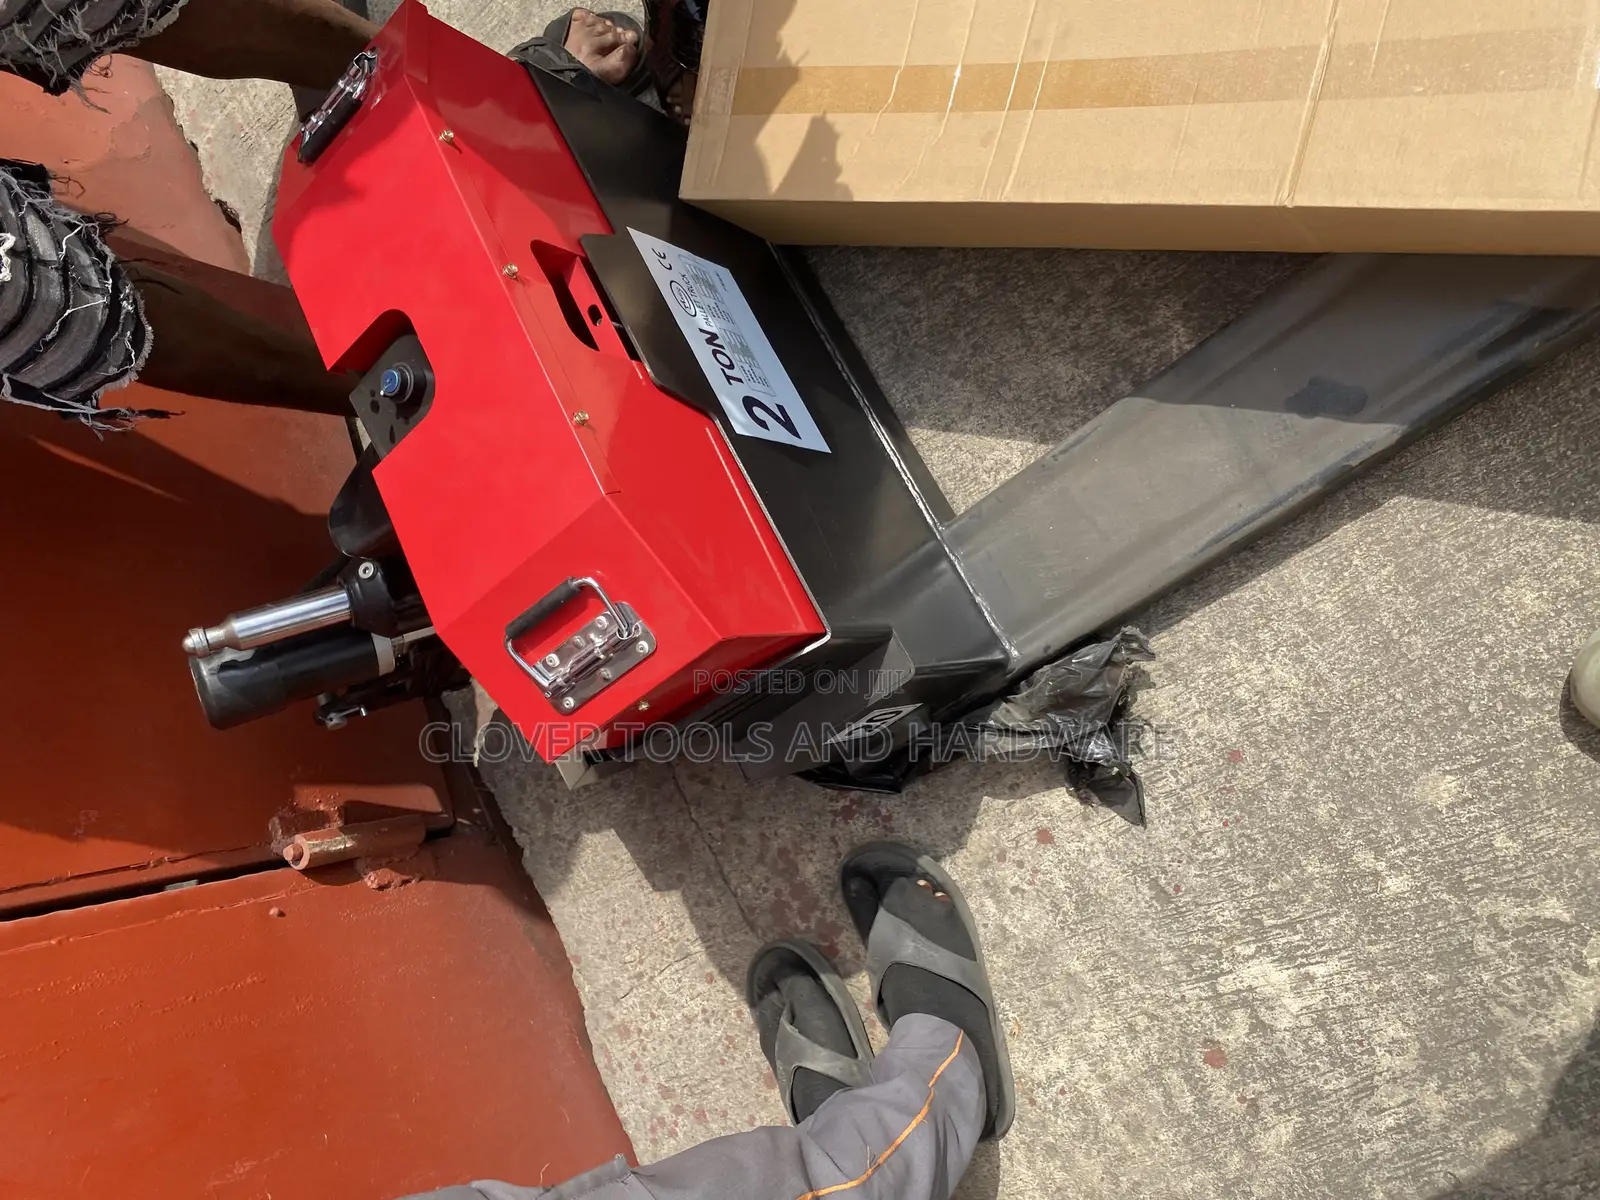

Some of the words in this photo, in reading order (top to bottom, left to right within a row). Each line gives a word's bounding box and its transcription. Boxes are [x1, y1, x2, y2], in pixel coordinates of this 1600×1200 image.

[680, 272, 698, 299] TRUCK
[693, 298, 713, 328] PALLET
[698, 327, 745, 386] TON
[741, 395, 802, 440] 2
